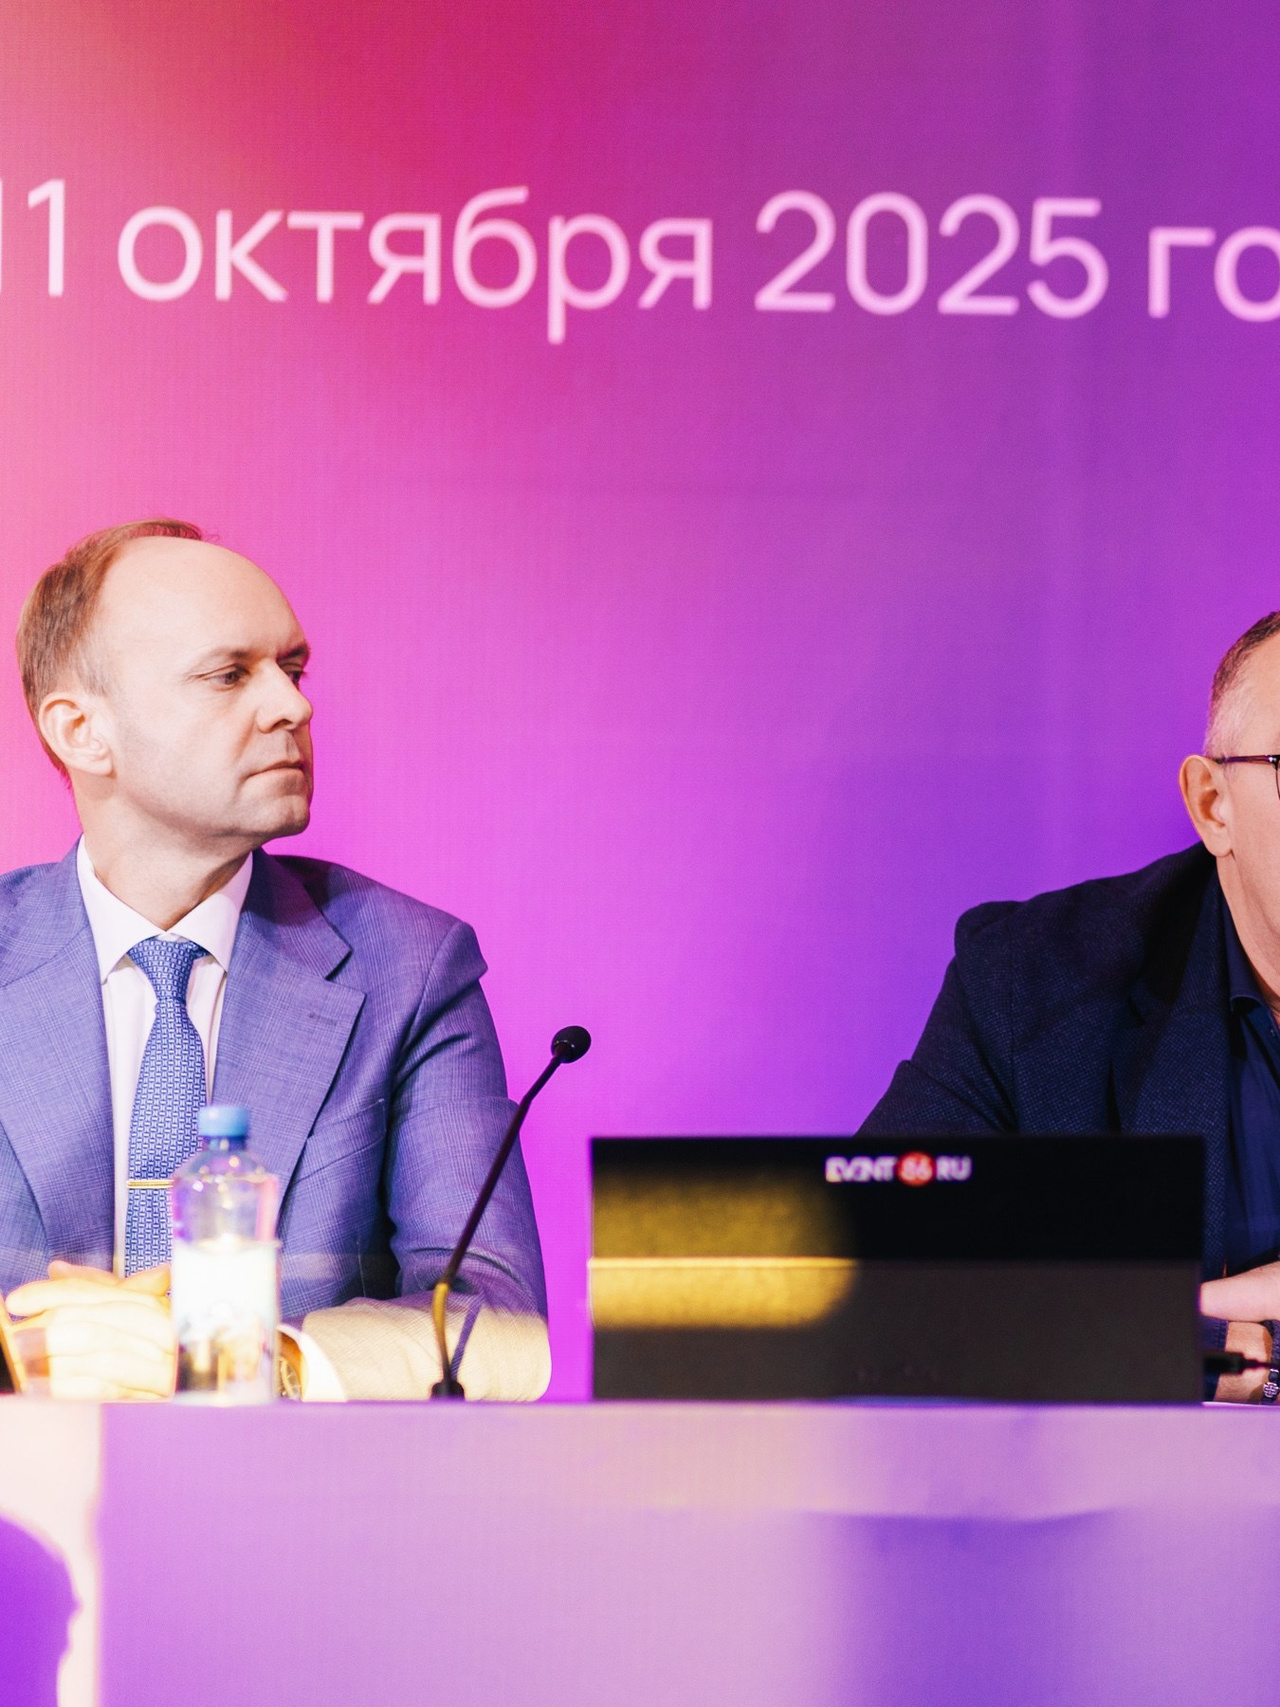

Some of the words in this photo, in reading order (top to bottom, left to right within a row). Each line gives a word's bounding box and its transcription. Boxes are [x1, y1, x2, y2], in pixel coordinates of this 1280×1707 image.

[0, 178, 65, 297] 1
[117, 185, 713, 345] октября
[754, 189, 1109, 319] 2025
